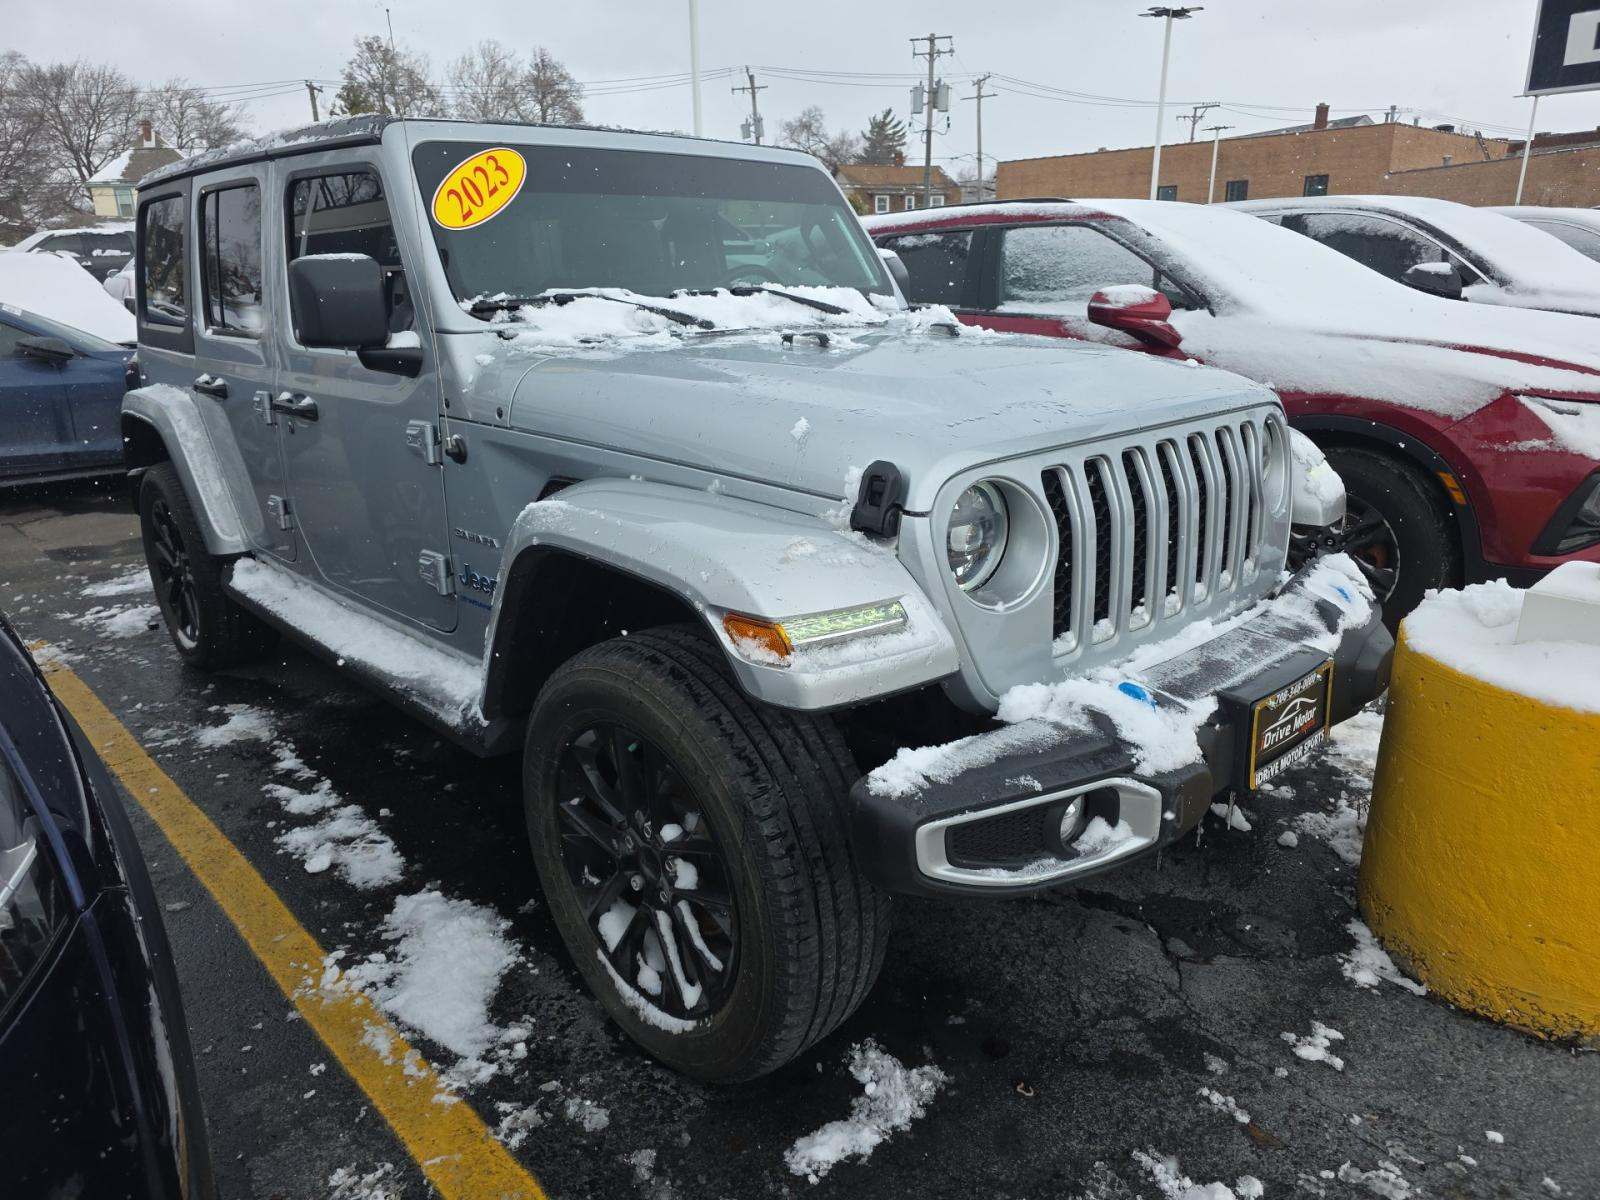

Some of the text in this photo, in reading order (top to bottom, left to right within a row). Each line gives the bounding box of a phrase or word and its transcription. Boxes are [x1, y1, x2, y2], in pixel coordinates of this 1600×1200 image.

[446, 155, 509, 222] 2023
[1293, 706, 1317, 733] Motor
[1280, 744, 1303, 768] MOTOR
[1303, 729, 1325, 755] SPORTS
